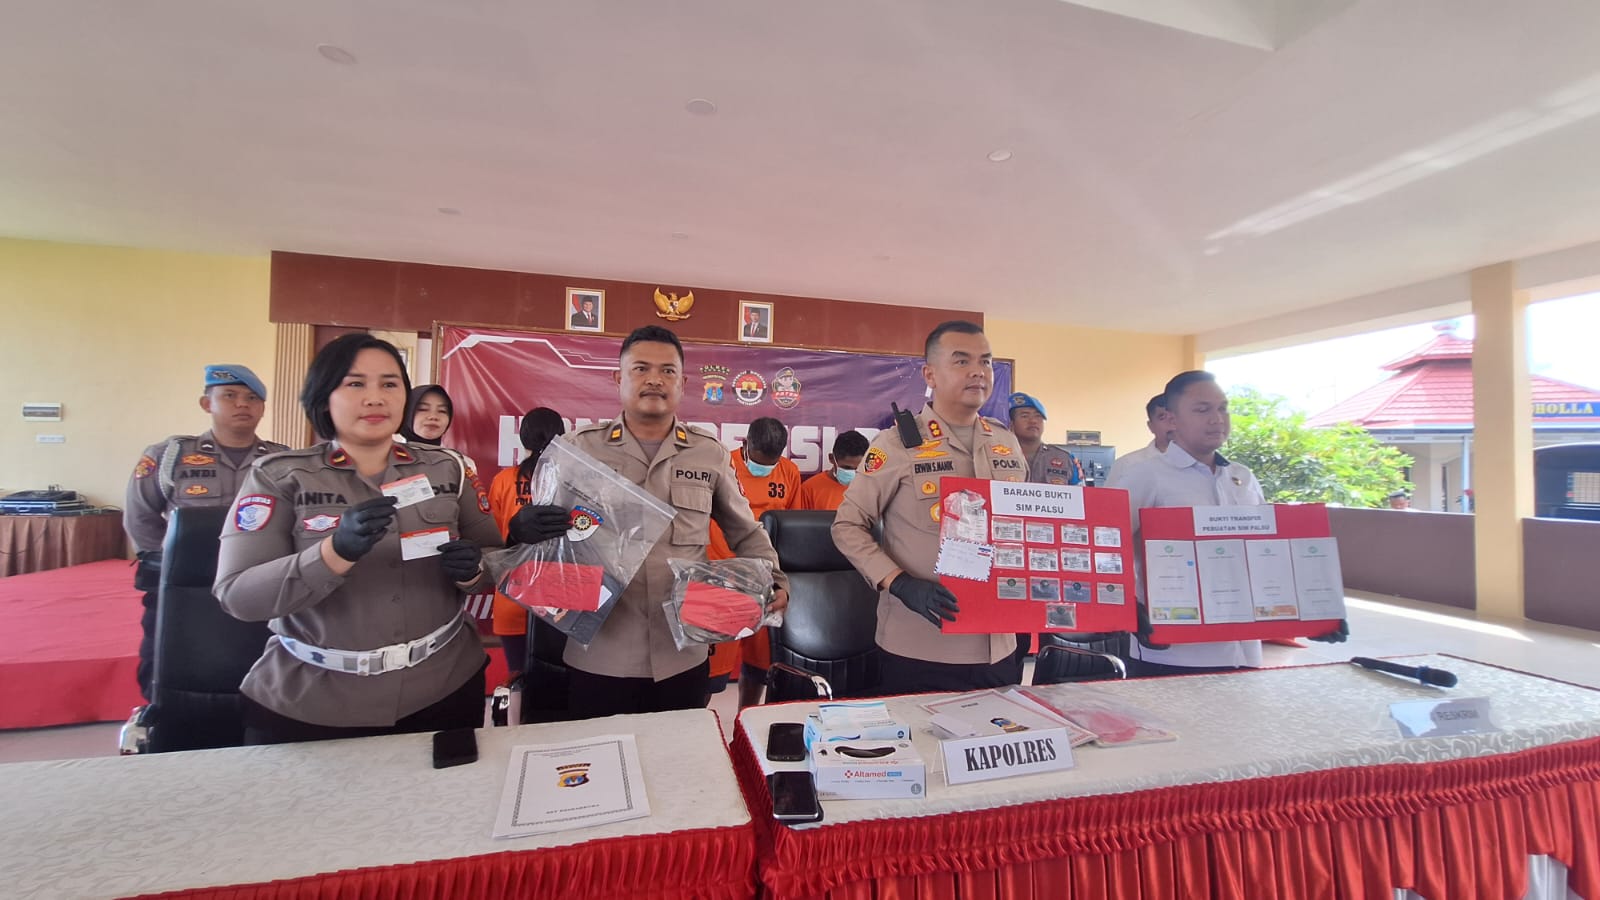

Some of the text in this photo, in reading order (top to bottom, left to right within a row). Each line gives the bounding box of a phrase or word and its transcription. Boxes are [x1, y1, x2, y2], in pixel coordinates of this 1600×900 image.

[1533, 402, 1594, 415] HOLLA
[992, 459, 1021, 470] POLRI
[179, 469, 217, 479] ANDI
[676, 469, 712, 483] POLRI
[1047, 468, 1068, 476] POLRI
[768, 481, 785, 499] 33
[1003, 487, 1072, 500] BARANG BUKTI
[1016, 503, 1064, 514] SIM PALSU
[963, 738, 1057, 772] KAPOLRES
[854, 770, 887, 778] Altamed
